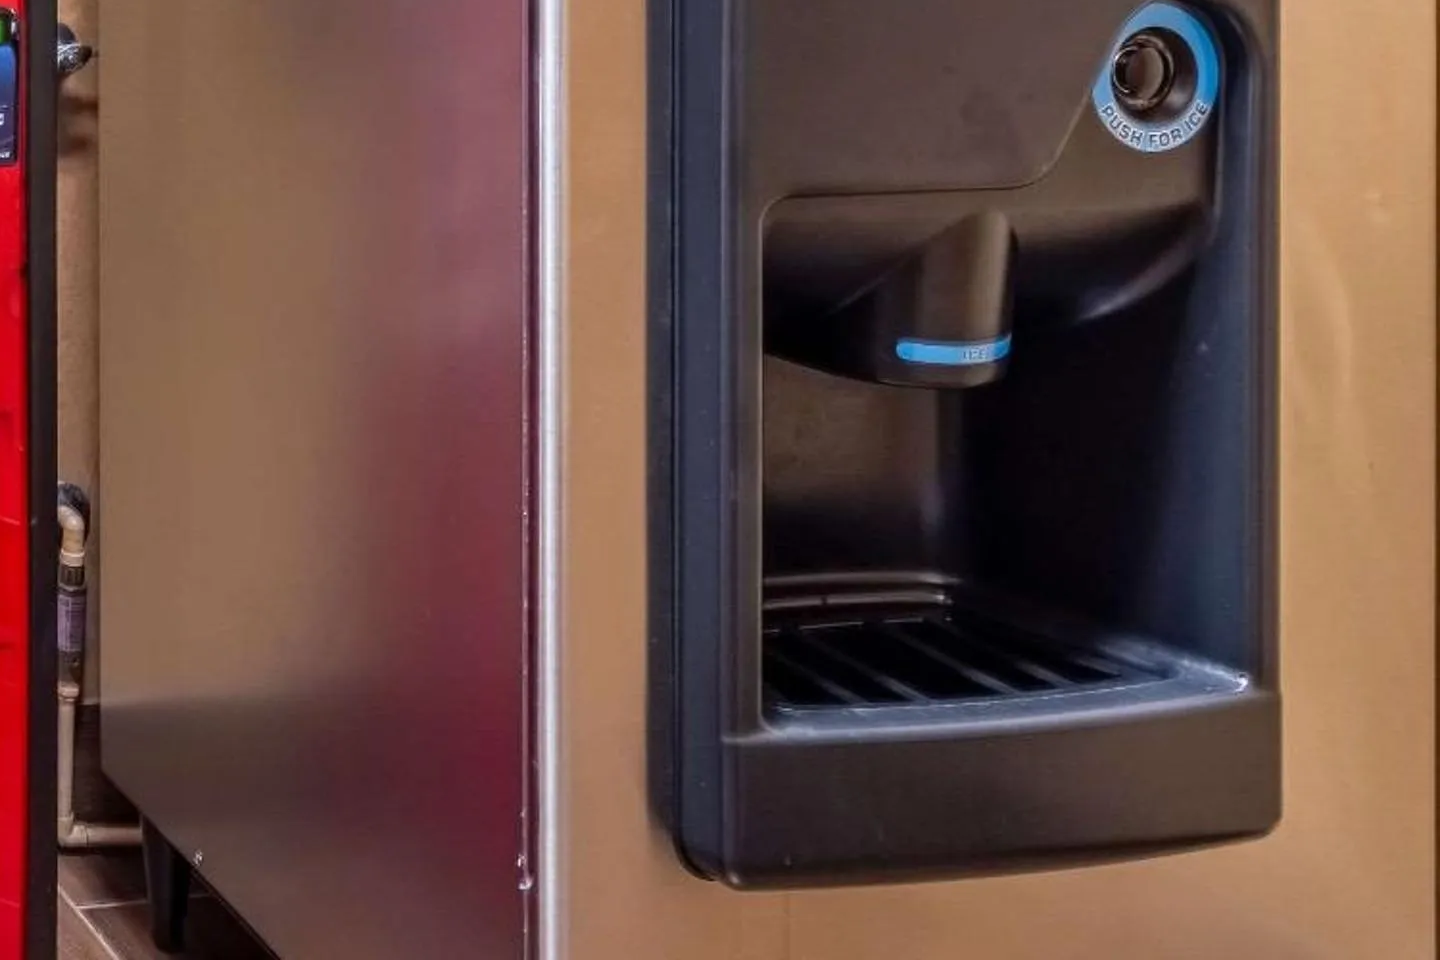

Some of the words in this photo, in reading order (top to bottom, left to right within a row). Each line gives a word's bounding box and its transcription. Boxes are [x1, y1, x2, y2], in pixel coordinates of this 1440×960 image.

[1101, 103, 1144, 146] PUSH
[1147, 127, 1184, 147] FOR
[1184, 100, 1209, 131] ICE
